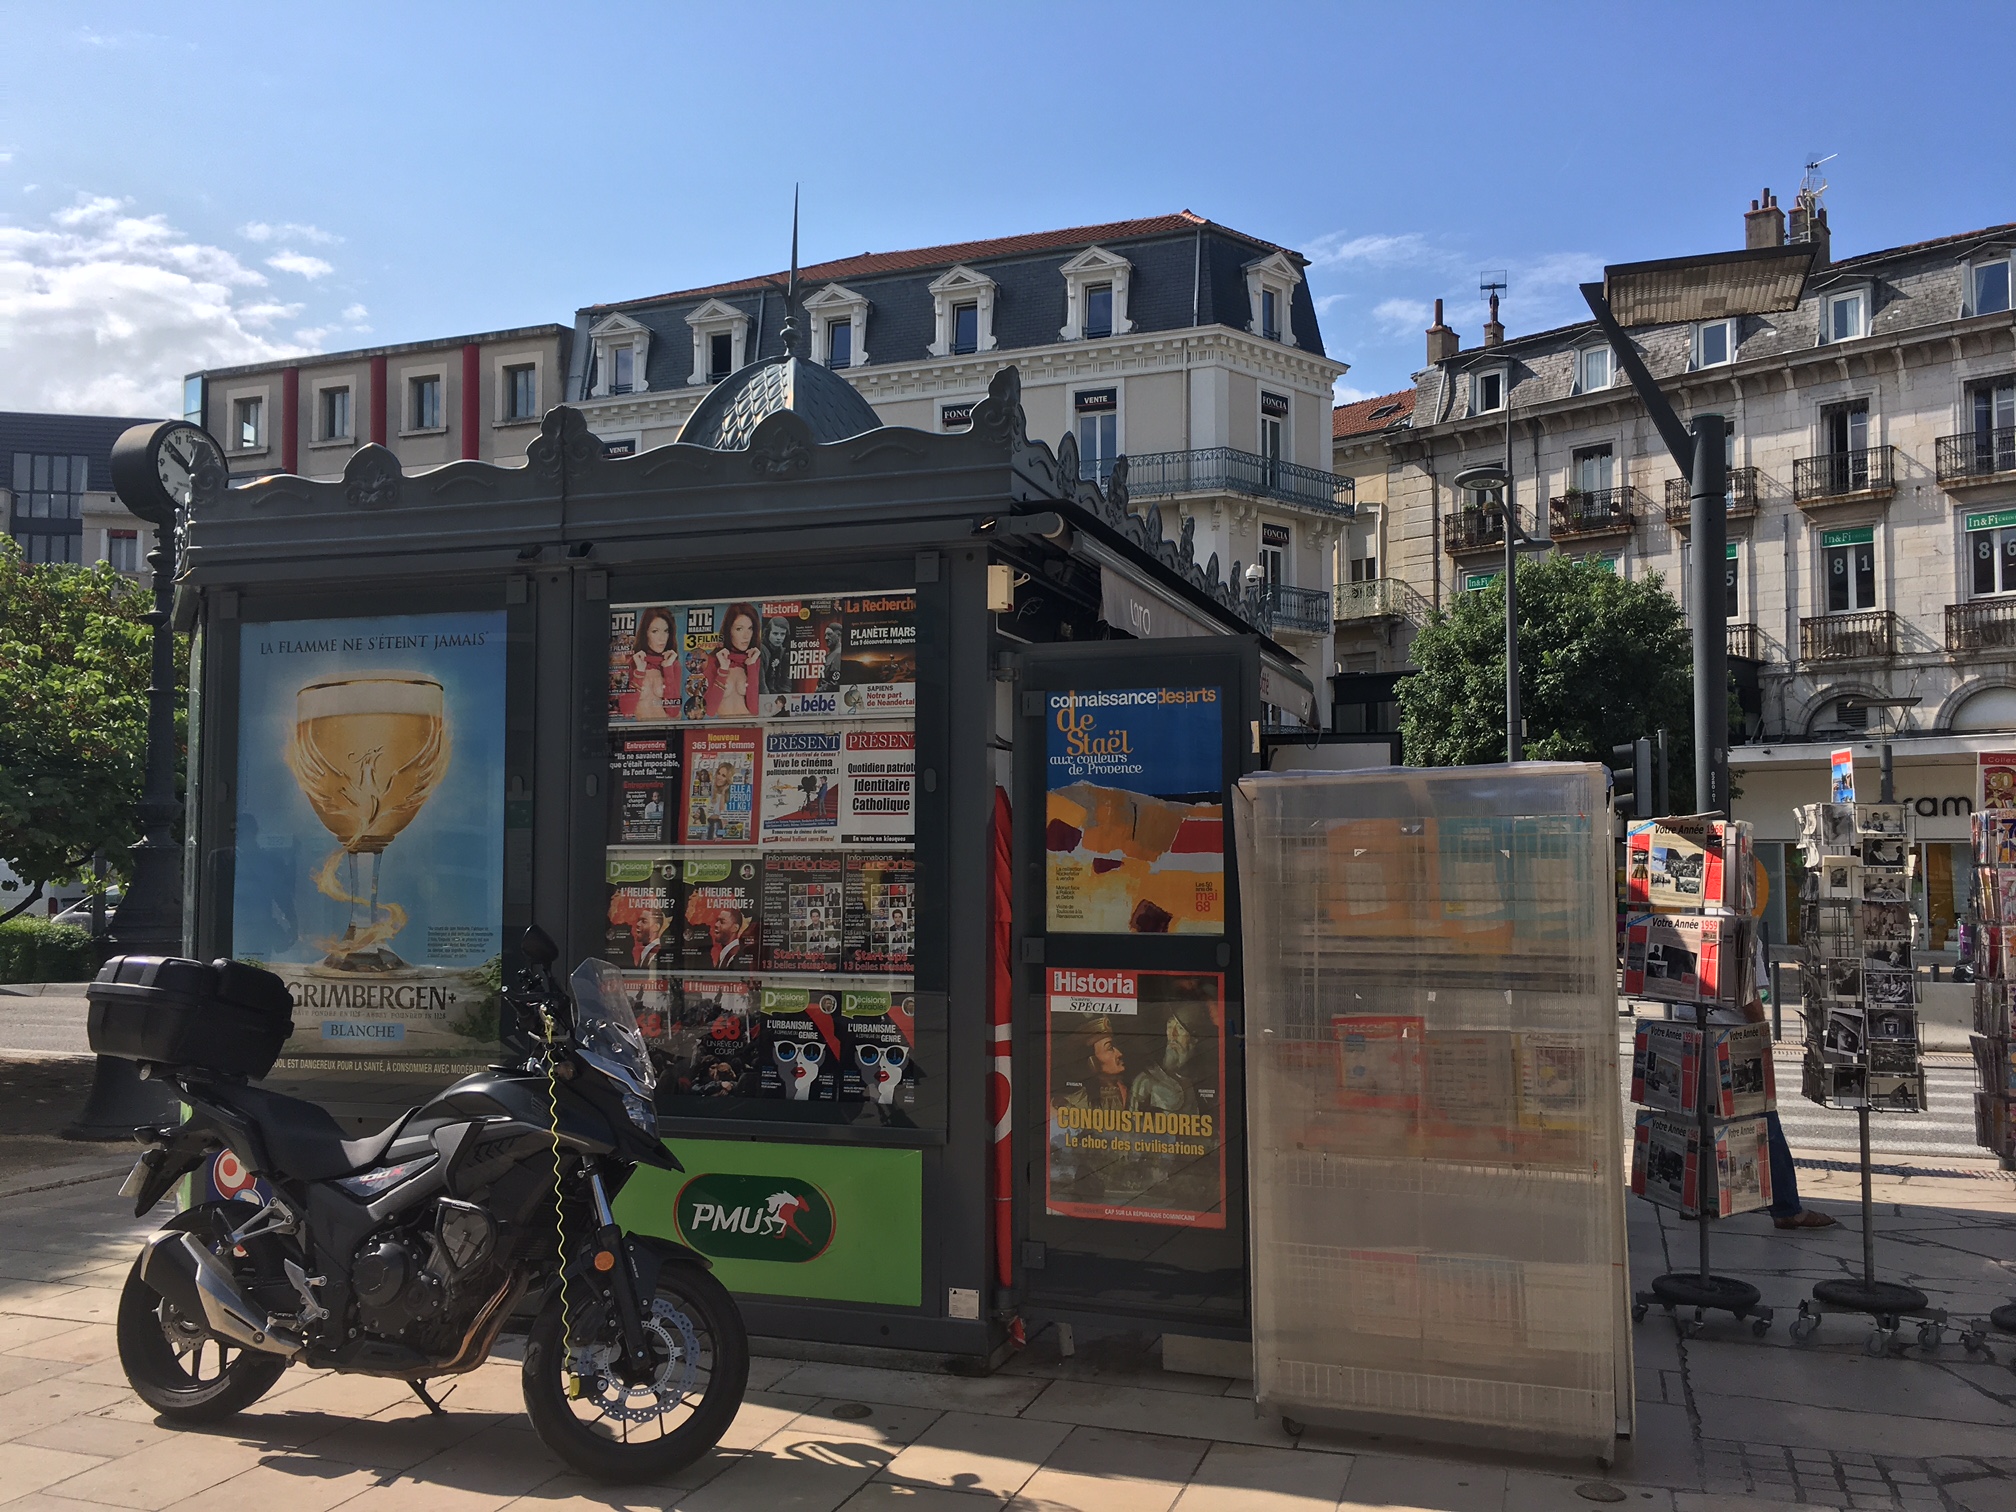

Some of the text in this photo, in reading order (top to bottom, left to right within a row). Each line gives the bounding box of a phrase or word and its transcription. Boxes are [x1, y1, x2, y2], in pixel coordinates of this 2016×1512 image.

[1084, 394, 1107, 405] VENTE
[1262, 395, 1288, 412] FONCIA
[944, 409, 970, 419] FONC
[609, 446, 630, 455] VENTE
[159, 458, 165, 467] 9
[162, 473, 169, 482] 8
[1969, 514, 1998, 527] In&Fi
[1263, 527, 1290, 542] FONCIA
[1824, 532, 1851, 544] In&Fi
[1979, 542, 1990, 559] 8
[1834, 555, 1870, 574] 8 1
[1726, 570, 1734, 586] 5
[762, 602, 799, 615] Historia
[846, 600, 859, 613] La
[1130, 599, 1151, 635] LOTO
[850, 625, 916, 639] PLANÈTE MARS
[260, 642, 274, 655] LA
[278, 639, 337, 653] FLAMME
[343, 638, 362, 651] NE
[368, 633, 428, 650] S'ÉTEINT
[686, 634, 724, 648] 3 FILMS
[790, 638, 820, 649] Ils ont osé
[790, 647, 826, 664] DÉFIER
[789, 665, 826, 680] HITLER
[867, 691, 902, 700] Notre part
[791, 694, 836, 713] Le bébé
[867, 697, 915, 707] de Neandertal
[1056, 690, 1097, 733] de
[707, 734, 740, 742] Nouveau
[768, 733, 840, 750] PRÉSENT
[1066, 729, 1134, 756] Staël
[626, 741, 666, 750] Entreprendre
[692, 741, 755, 750] 365 jours femme
[635, 752, 663, 760] savaient
[664, 753, 677, 761] pas
[1050, 753, 1127, 765] aux couleurs
[643, 760, 680, 769] impossible,
[773, 758, 833, 768] Vive le cinéma
[848, 763, 885, 773] Quotidien
[1068, 763, 1143, 775] de Provence
[766, 768, 807, 776] politiquement
[730, 785, 745, 793] ELLE
[854, 779, 910, 792] Identitaire
[730, 793, 751, 801] PERDU
[852, 798, 910, 812] Catholique
[1655, 824, 1724, 835] Votre Année 1968
[765, 859, 841, 870] Entreprise
[847, 859, 915, 870] Entrepris
[620, 887, 666, 897] L'HEURE DE
[698, 887, 745, 897] L'HEURE DE
[1195, 889, 1217, 901] mai
[1195, 901, 1211, 912] 68
[1652, 917, 1718, 930] Votre Année 1959
[774, 950, 825, 960] Start-ups
[855, 950, 907, 962] Start-ups
[762, 960, 837, 970] 13 belles réussites
[844, 961, 878, 970] 13 belles
[1054, 971, 1134, 994] Historia
[287, 981, 447, 1011] GRIMBERGEN
[1069, 1001, 1122, 1013] SPÉCIAL
[330, 1024, 395, 1038] BLANCHE
[711, 1015, 741, 1041] 68
[767, 1019, 814, 1031] L'URBANISME
[847, 1023, 896, 1034] L'URBANISME
[798, 1031, 818, 1040] GENRE
[881, 1034, 901, 1043] GENRE
[1650, 1026, 1665, 1037] Votre
[1666, 1028, 1682, 1041] Année
[1729, 1029, 1742, 1041] Votre
[1743, 1028, 1759, 1039] Année
[288, 1058, 299, 1069] EST
[300, 1059, 336, 1070] DANGEREUX
[336, 1060, 353, 1071] POUR
[354, 1061, 363, 1071] LA
[386, 1060, 392, 1071] À
[392, 1062, 433, 1073] CONSOMMER
[433, 1063, 450, 1074] AVEC
[1057, 1106, 1213, 1137] CONQUISTADORES
[1652, 1119, 1698, 1139] Votre Année 1945
[1728, 1128, 1740, 1138] Votre
[1740, 1126, 1755, 1138] Année
[1065, 1134, 1205, 1156] Le choc des civilisations
[691, 1203, 764, 1234] PMU
